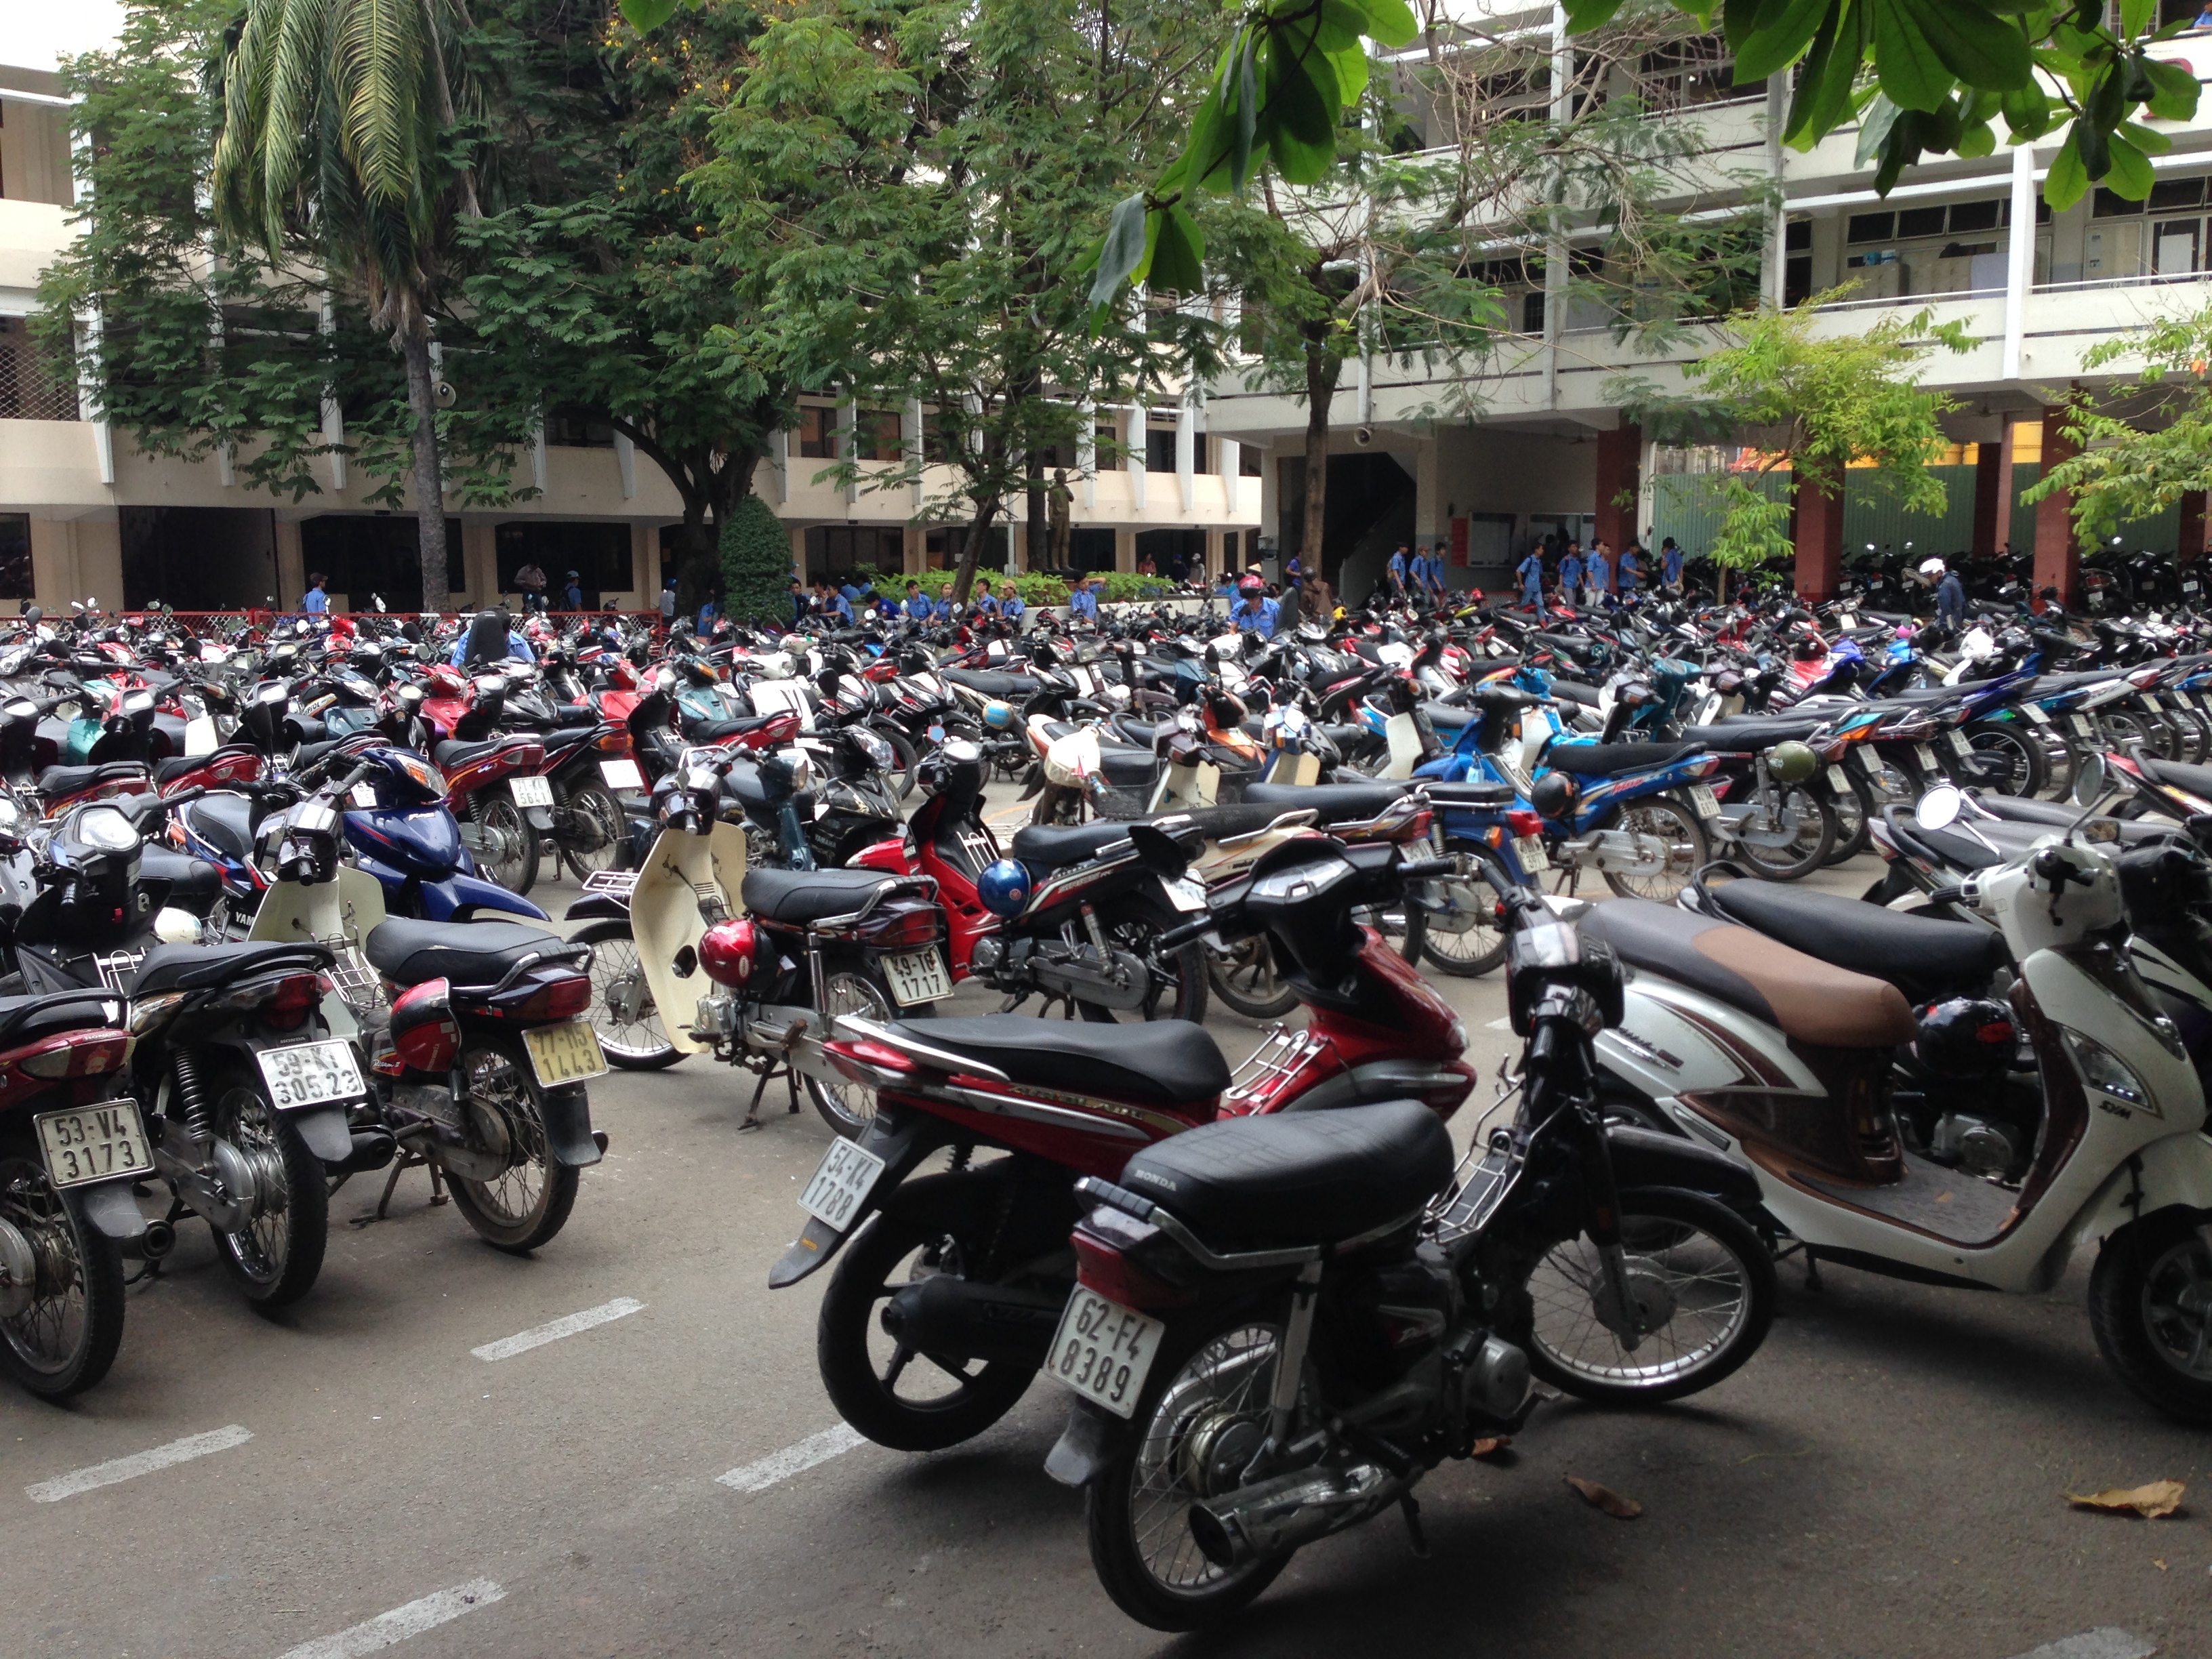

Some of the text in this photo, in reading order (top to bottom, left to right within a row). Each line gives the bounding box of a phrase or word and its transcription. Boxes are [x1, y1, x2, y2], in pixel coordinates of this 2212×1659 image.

[520, 792, 547, 805] 5641
[902, 973, 941, 999] 1717
[83, 1031, 118, 1041] HONDA
[280, 1036, 306, 1044] HONDA
[272, 1045, 339, 1077] 59-K1
[542, 1048, 596, 1080] 1443
[55, 1109, 127, 1147] 53-V4
[62, 1139, 136, 1179] 3173
[827, 1145, 874, 1191] 54-K4
[1134, 1168, 1178, 1192] HONDA
[808, 1176, 855, 1222] 1788
[1076, 1297, 1148, 1361] 62-F4
[1060, 1337, 1132, 1404] 8389
